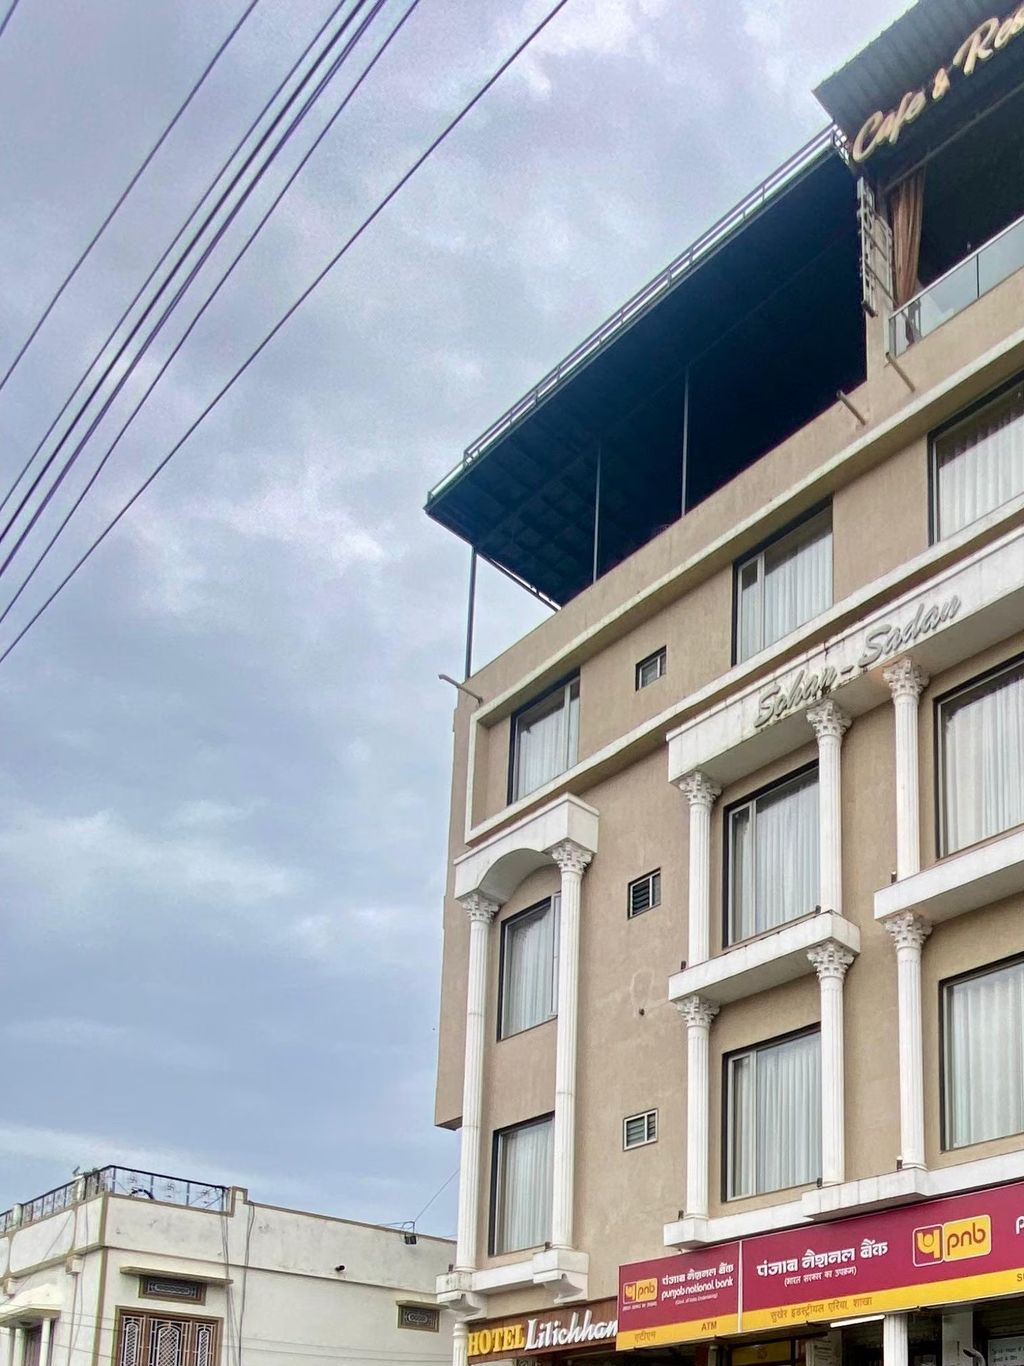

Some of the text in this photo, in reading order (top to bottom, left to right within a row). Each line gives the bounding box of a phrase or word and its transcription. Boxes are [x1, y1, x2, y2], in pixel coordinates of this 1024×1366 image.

[947, 1222, 986, 1256] pnb
[757, 1239, 888, 1277] पंजाब नैशनल बैंक
[638, 1282, 655, 1299] pnb
[661, 1286, 685, 1301] punjab
[685, 1280, 715, 1294] national
[715, 1276, 733, 1289] bank
[467, 1324, 525, 1356] HOTEL
[701, 1321, 718, 1332] ATM
